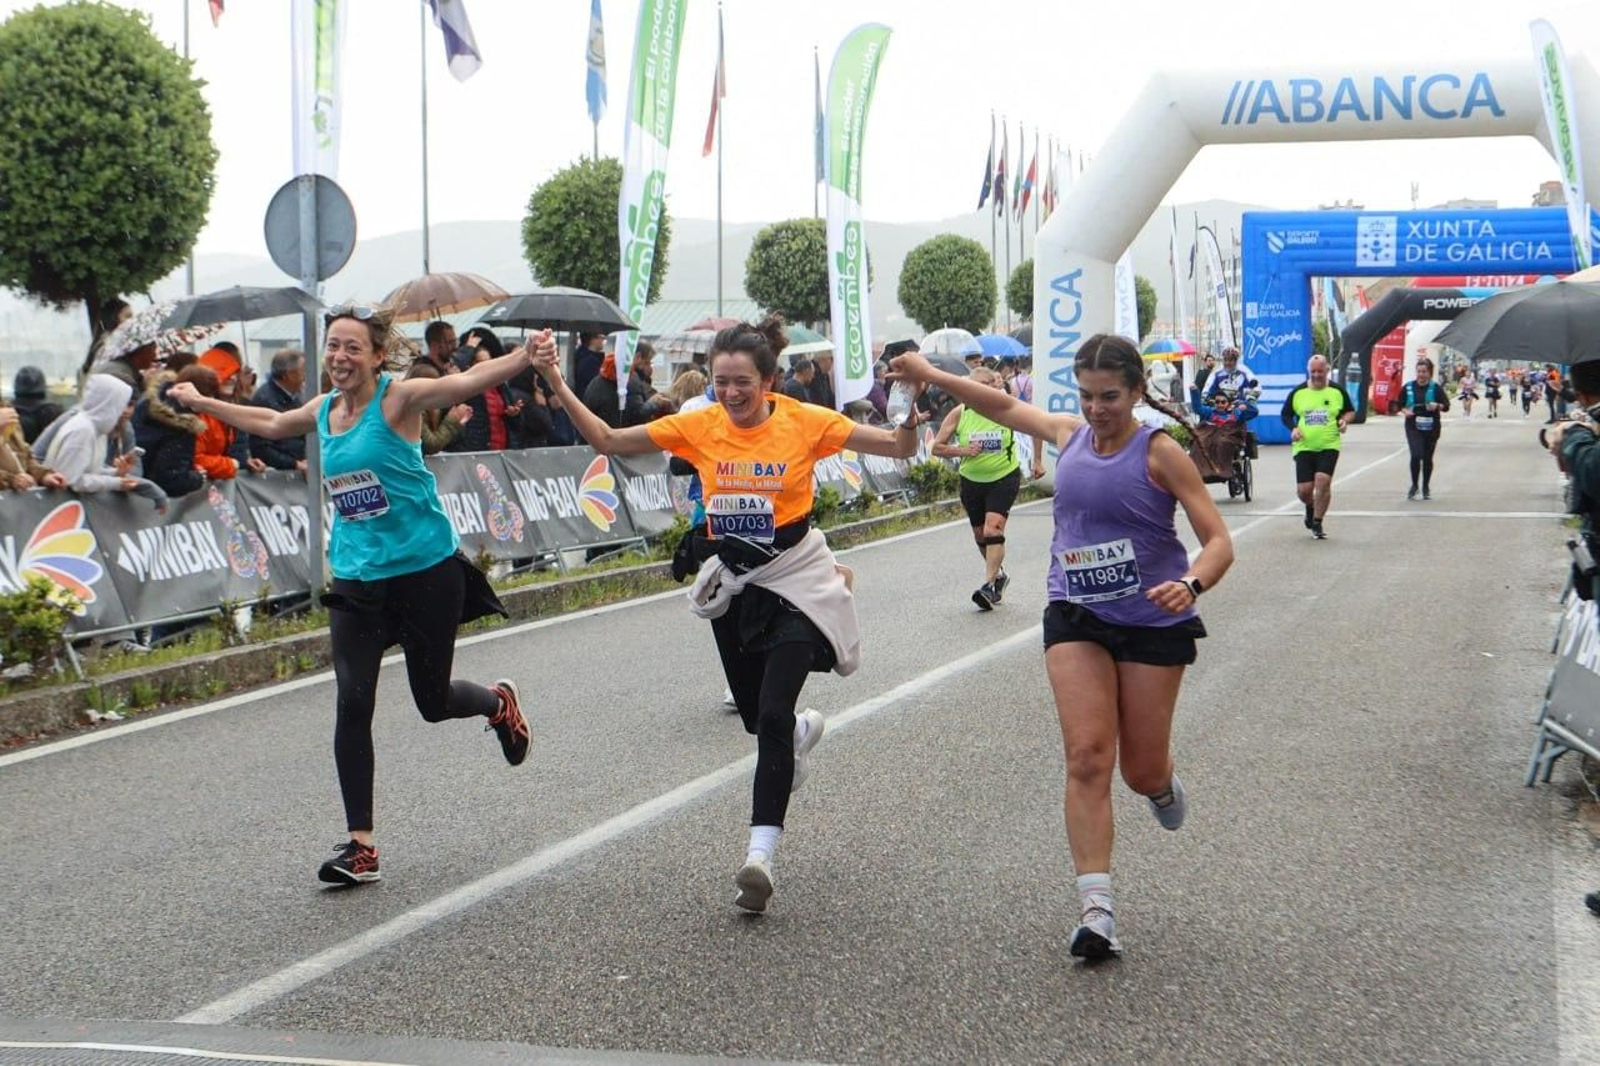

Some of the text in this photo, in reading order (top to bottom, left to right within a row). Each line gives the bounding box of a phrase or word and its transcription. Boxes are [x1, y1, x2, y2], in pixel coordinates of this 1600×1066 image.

[645, 0, 664, 80] El pode
[1407, 219, 1497, 239] XUNTA
[1405, 240, 1552, 263] DE GALICIA
[847, 226, 863, 374] ecoembes
[716, 462, 786, 476] MINIBAY
[328, 470, 373, 490] MINIBAY
[341, 487, 379, 508] 10702
[711, 498, 766, 510] MINIBAY
[719, 516, 767, 531] 10703
[118, 520, 228, 583] MINIBAY
[1065, 543, 1125, 565] MINIBAY
[1078, 564, 1127, 587] 11987
